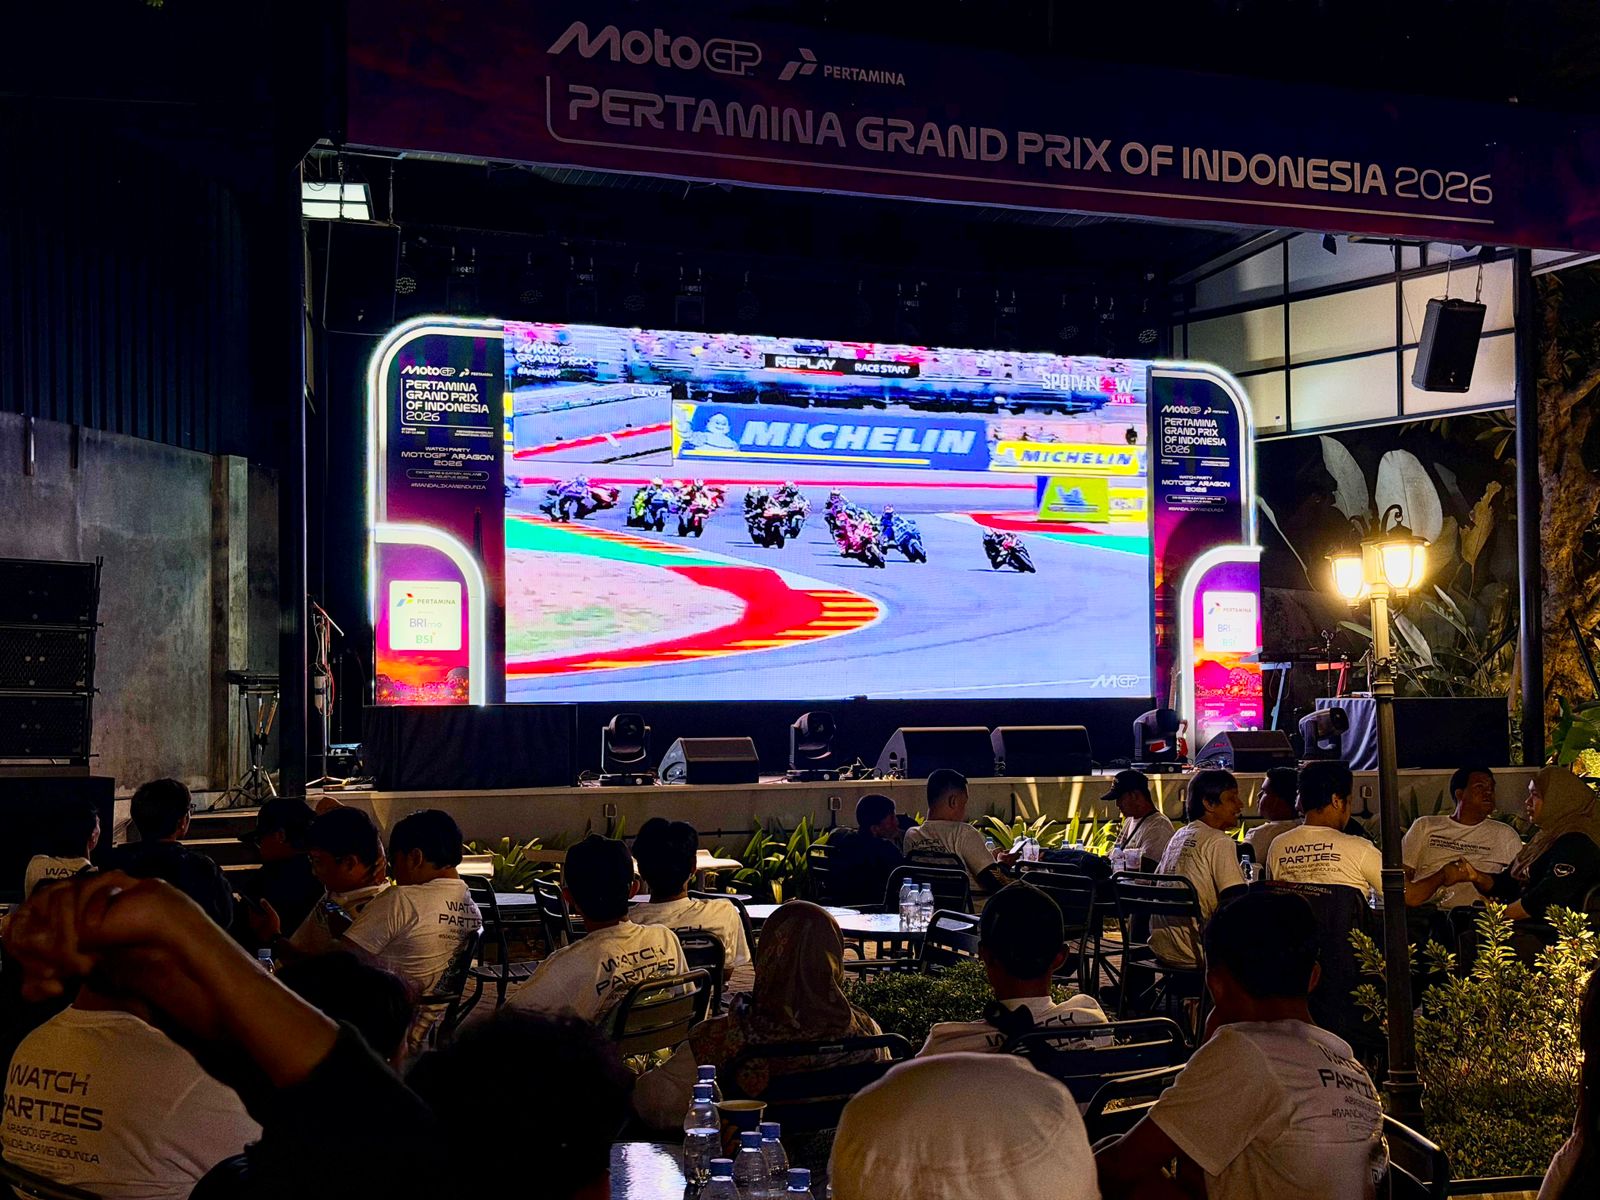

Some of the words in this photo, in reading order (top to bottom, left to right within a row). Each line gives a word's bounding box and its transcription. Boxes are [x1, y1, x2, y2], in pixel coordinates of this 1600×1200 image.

[824, 65, 906, 86] PERTAMINA
[569, 84, 846, 148] PERTAMINA
[856, 116, 1008, 162] GRAND
[1017, 131, 1112, 172] PRIX
[1120, 141, 1173, 176] OF
[1182, 146, 1388, 196] INDONESIA
[1395, 166, 1493, 205] 2026
[515, 353, 560, 364] GRAND
[560, 356, 594, 367] PRIX
[775, 356, 836, 371] REPLAY
[854, 363, 879, 374] RACE
[880, 363, 911, 375] START
[405, 379, 478, 392] PERTAMINA
[631, 386, 667, 398] LIVE
[405, 390, 449, 401] GRAND
[451, 392, 479, 403] PRIX
[1111, 394, 1131, 403] LIVE
[405, 401, 422, 411] OF
[425, 402, 489, 414] INDONESIA
[405, 412, 440, 422] 2026
[1164, 417, 1217, 428] PERTAMINA
[740, 420, 976, 454] MICHELIN
[1164, 427, 1196, 436] GRAND
[1198, 428, 1219, 437] PRIX
[1164, 436, 1177, 444] OF
[1178, 436, 1227, 446] INDONESIA
[1164, 445, 1190, 454] 2026
[433, 459, 463, 467] 2026
[451, 453, 494, 461] ARAGON
[1020, 449, 1132, 465] MICHELIN
[1198, 480, 1231, 488] ARAGON
[415, 634, 433, 644] BSI
[1285, 842, 1333, 854] WATCH
[1279, 853, 1341, 865] PARTIES
[446, 900, 477, 914] WATC
[601, 945, 665, 973] WATCH
[596, 958, 676, 996] PARTIES
[10, 1063, 91, 1096] WATCH
[1317, 1068, 1376, 1101] PARTI
[4, 1093, 103, 1132] ARTIES
[51, 1131, 78, 1146] 2026
